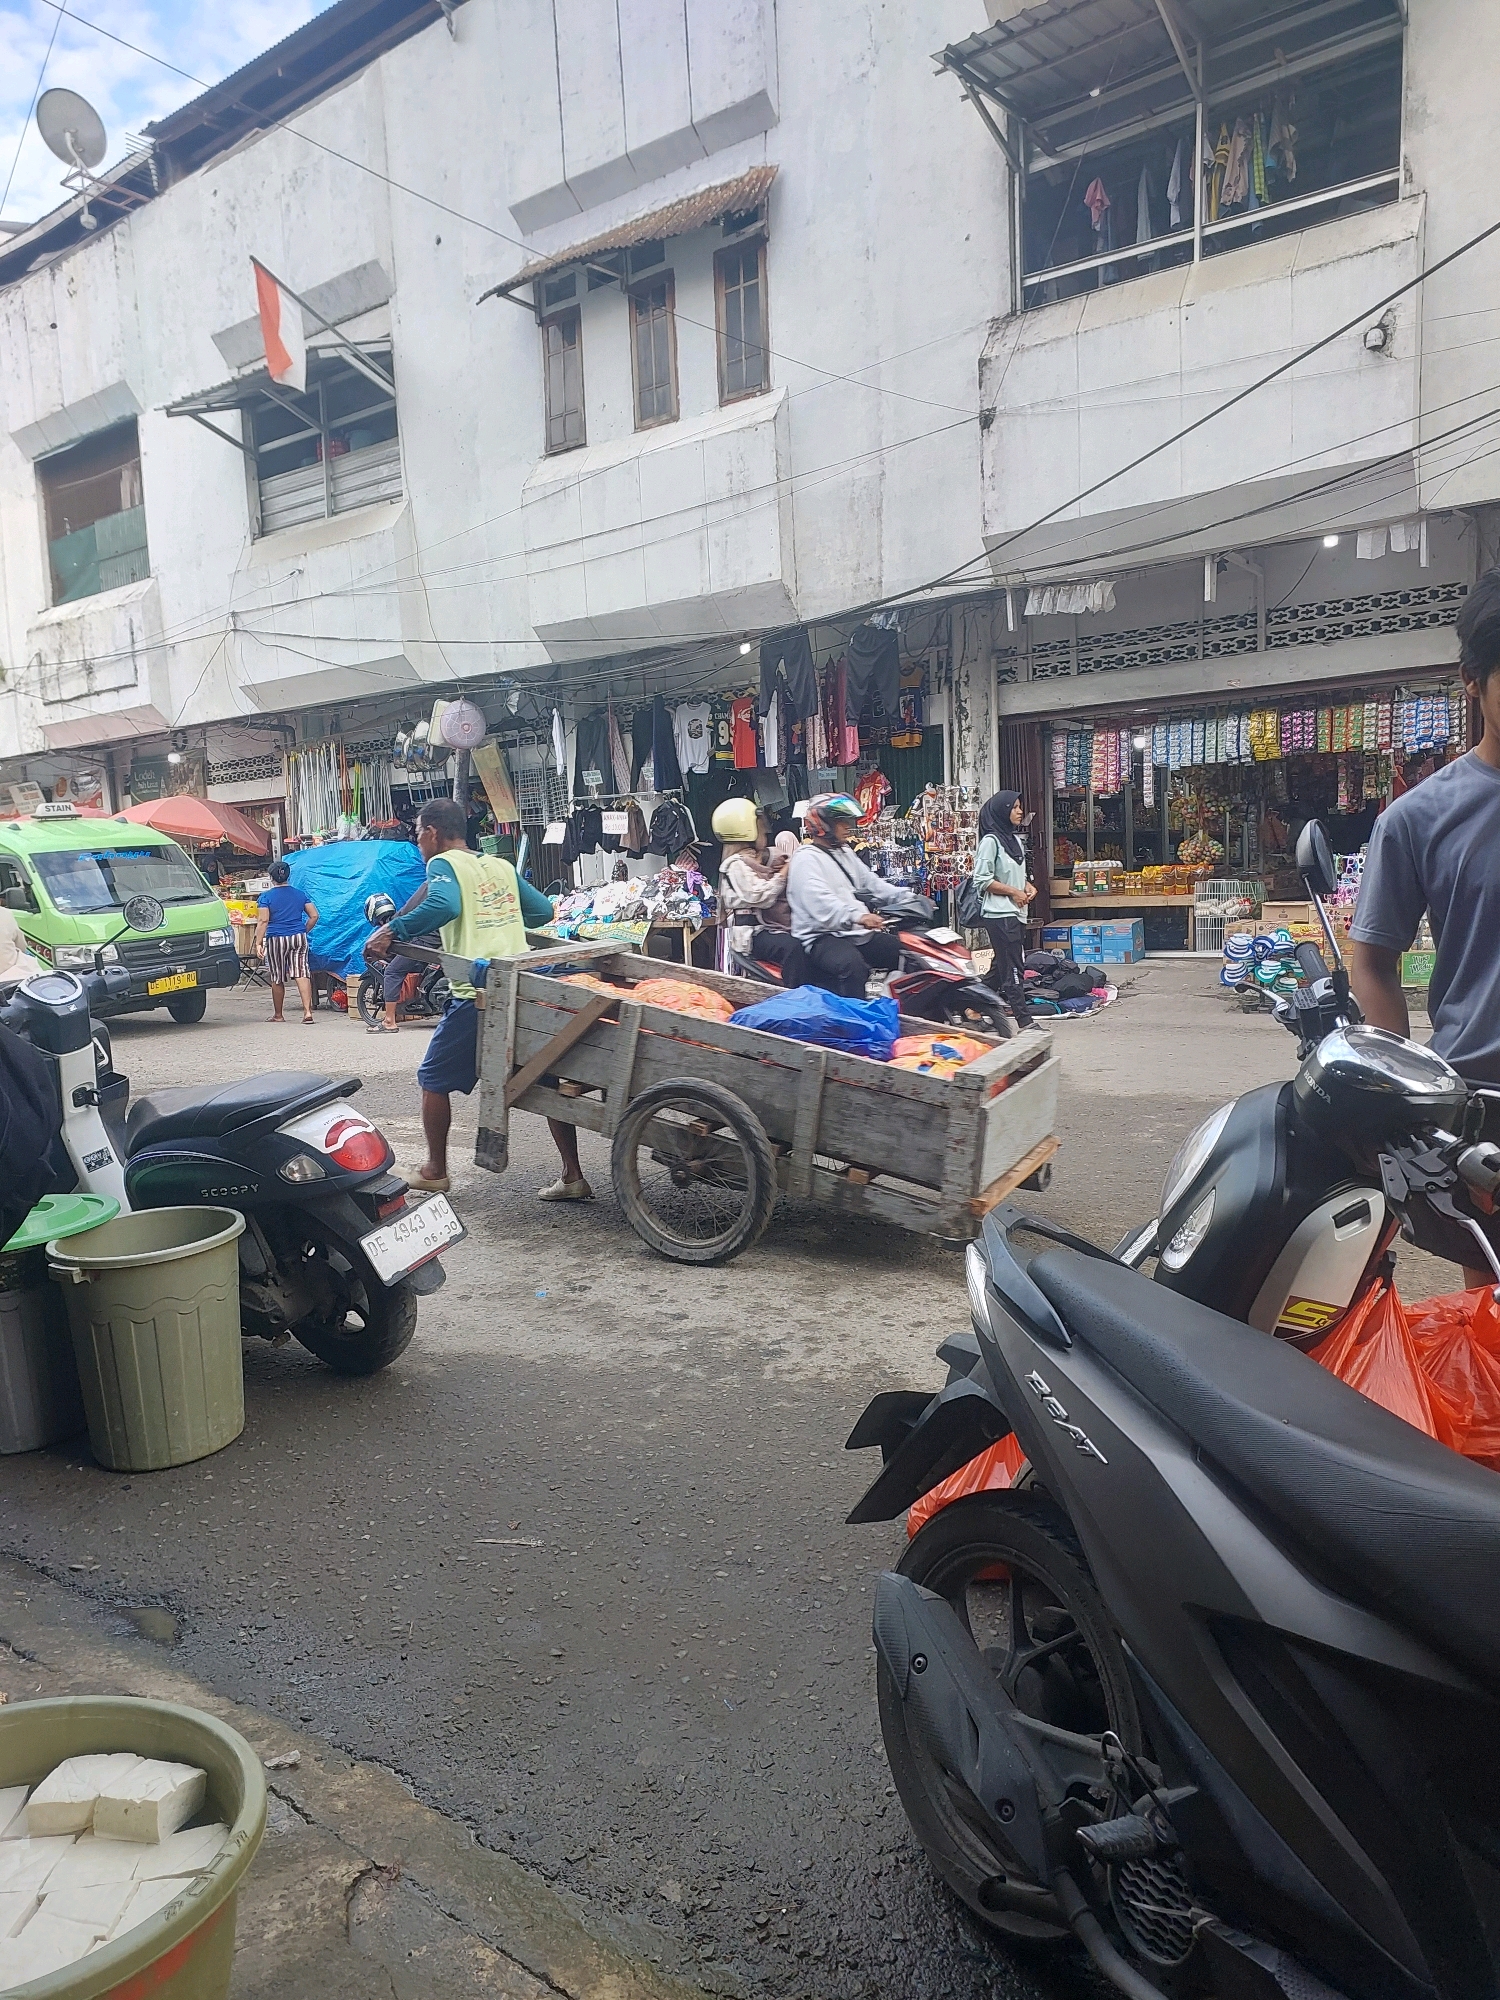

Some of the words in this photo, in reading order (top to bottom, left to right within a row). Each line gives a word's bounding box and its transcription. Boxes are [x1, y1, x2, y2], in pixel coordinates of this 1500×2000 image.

[44, 804, 72, 813] STAIN
[1303, 1069, 1332, 1105] HONDA
[200, 1183, 259, 1198] SCOOPY
[366, 1235, 389, 1258] DE
[393, 1213, 426, 1243] 4943
[428, 1200, 449, 1222] MC
